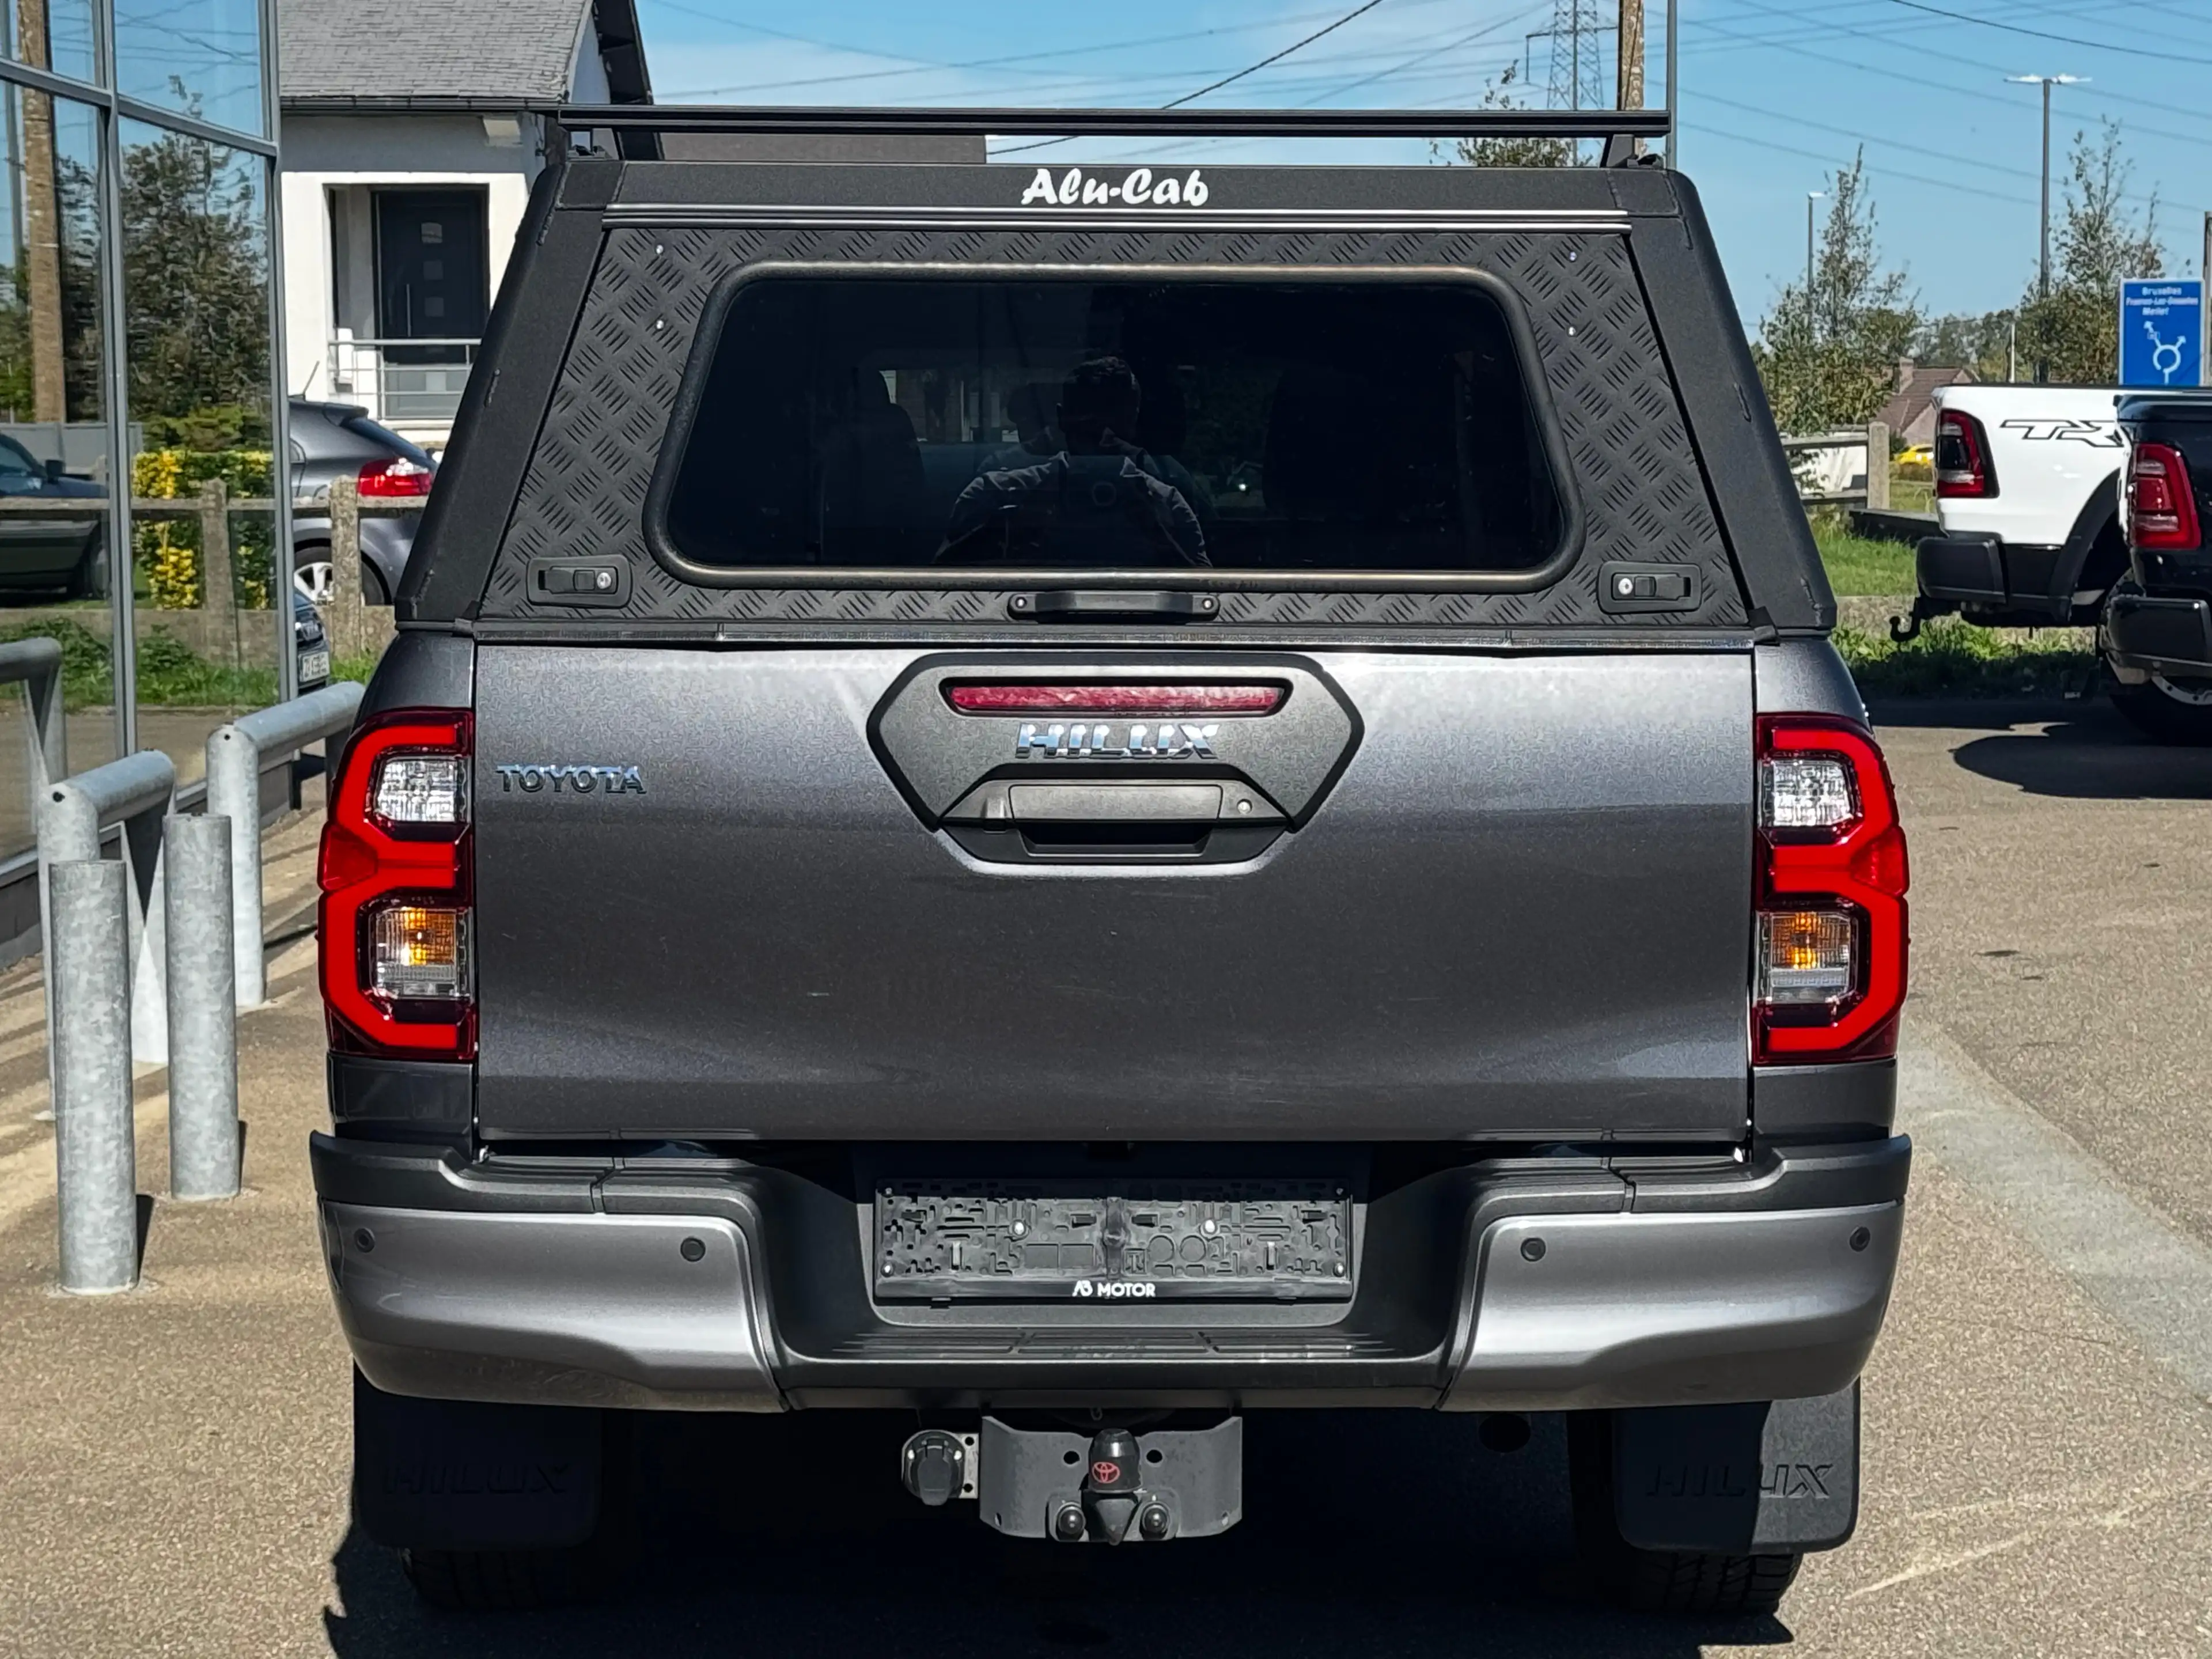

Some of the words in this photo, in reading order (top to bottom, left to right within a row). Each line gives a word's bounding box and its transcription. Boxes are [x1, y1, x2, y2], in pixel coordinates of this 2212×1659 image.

[1021, 167, 1209, 206] Alu-Cab
[1015, 723, 1220, 759] HILUX
[495, 764, 647, 794] TOYOTA
[1097, 1282, 1156, 1297] MOTOR
[1645, 1463, 1834, 1498] HILUX
